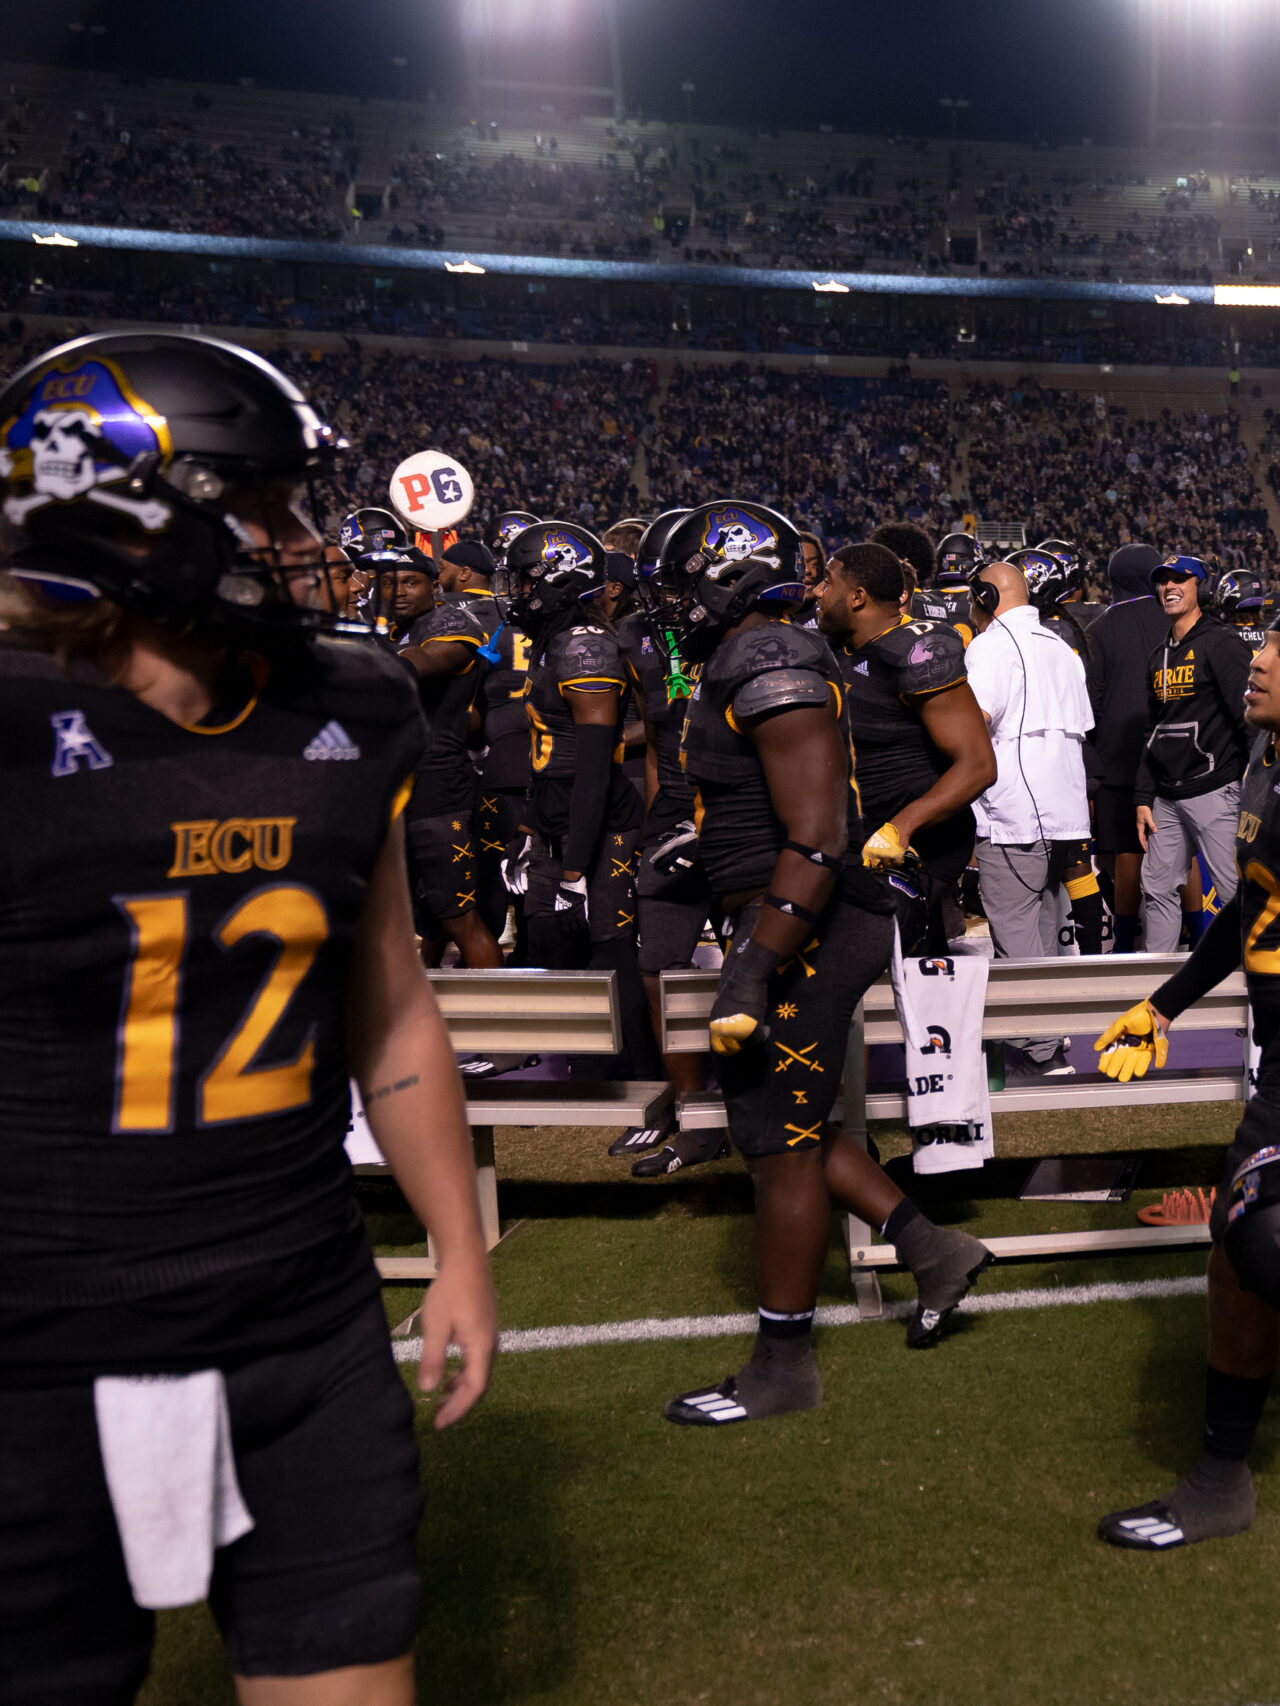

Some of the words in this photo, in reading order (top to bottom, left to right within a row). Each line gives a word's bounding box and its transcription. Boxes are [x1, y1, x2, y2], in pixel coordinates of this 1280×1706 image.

[42, 373, 97, 402] ECU
[167, 818, 297, 878] ECU
[111, 884, 332, 1136] 12
